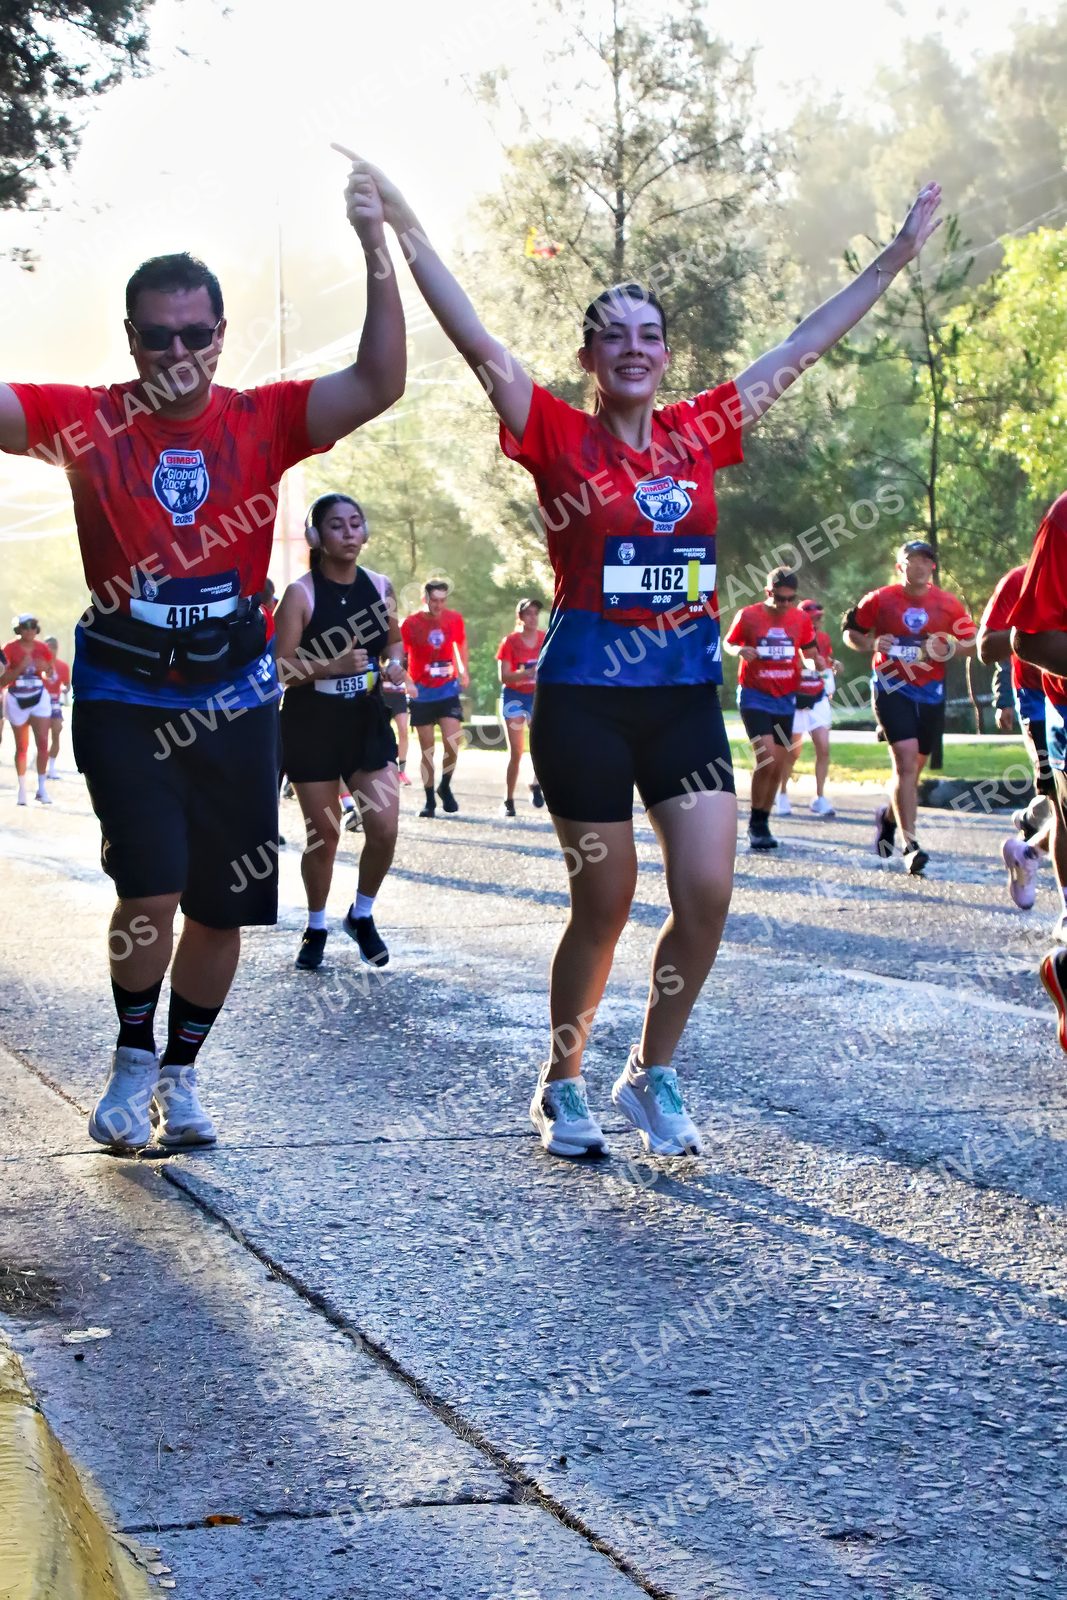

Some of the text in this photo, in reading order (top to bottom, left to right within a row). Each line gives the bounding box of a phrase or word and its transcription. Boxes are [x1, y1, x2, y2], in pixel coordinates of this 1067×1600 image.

[166, 456, 198, 465] BIMBO
[167, 468, 198, 480] Global
[162, 478, 186, 490] Race
[175, 514, 193, 524] 2026
[641, 567, 684, 591] 4162
[652, 595, 672, 604] 20-26
[166, 604, 209, 628] 4161
[336, 676, 364, 692] 4535
